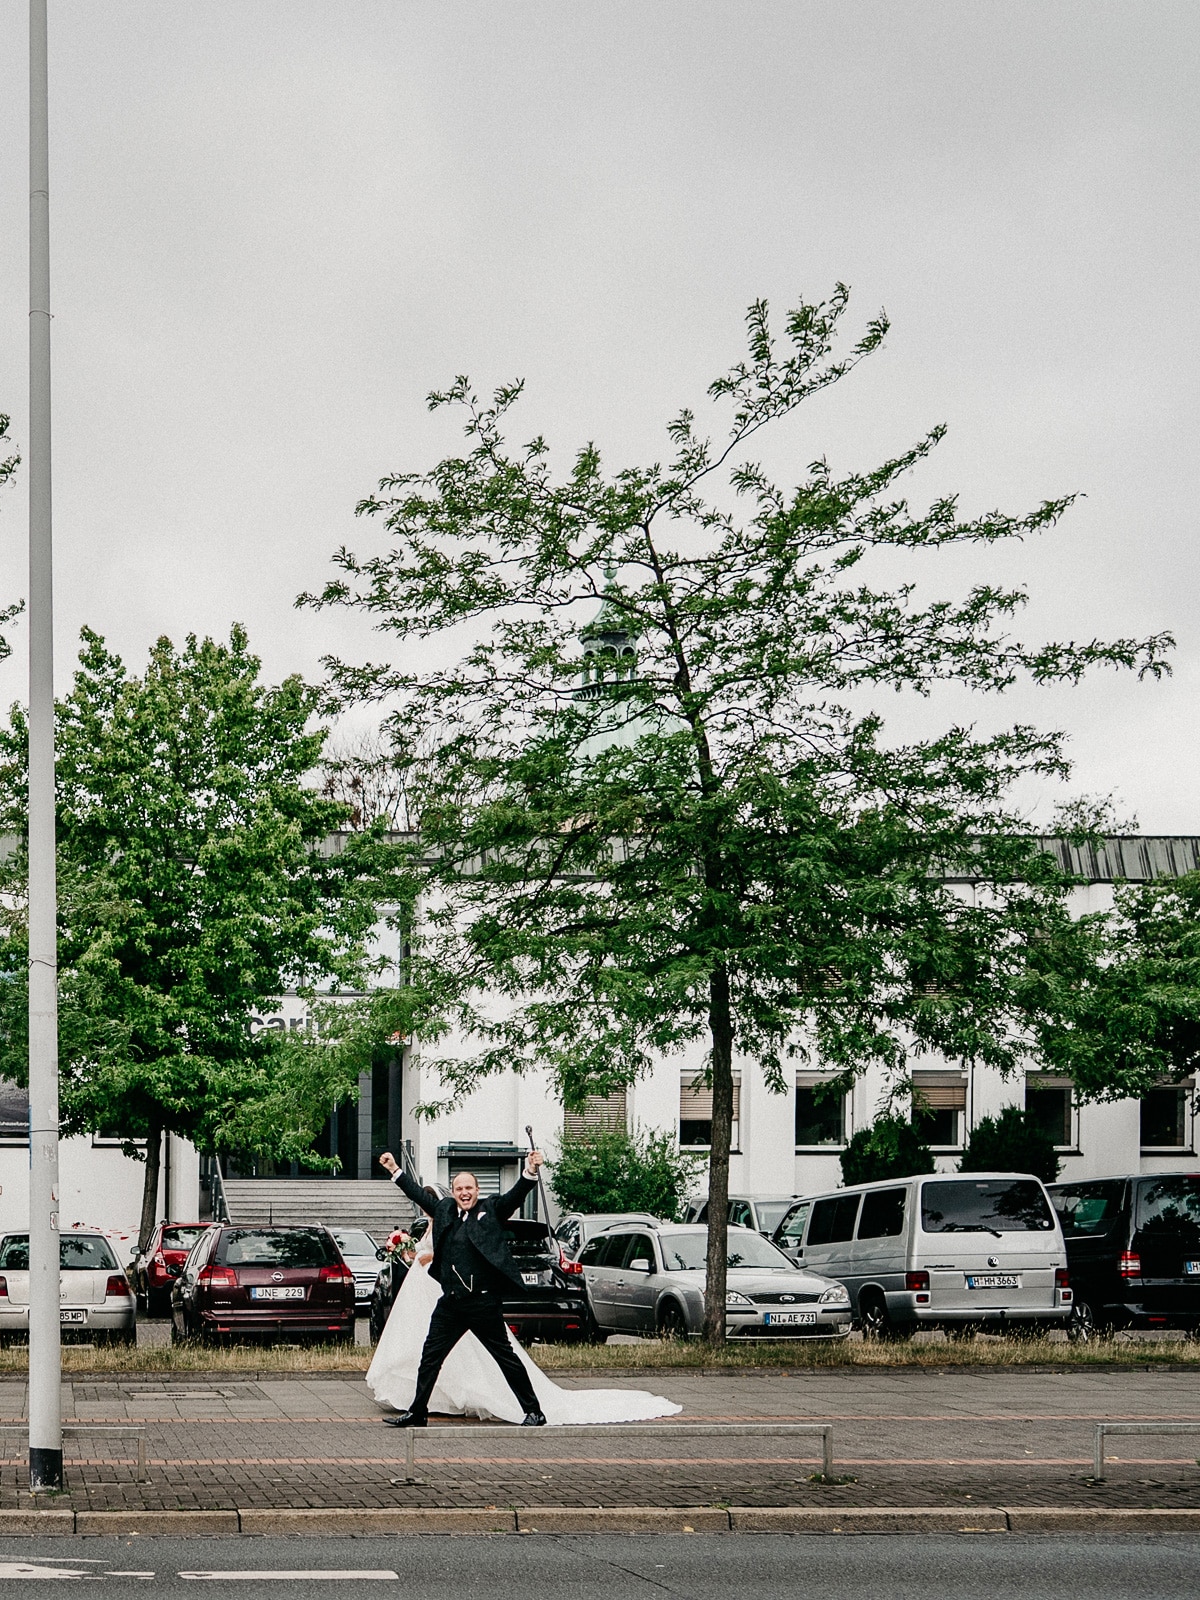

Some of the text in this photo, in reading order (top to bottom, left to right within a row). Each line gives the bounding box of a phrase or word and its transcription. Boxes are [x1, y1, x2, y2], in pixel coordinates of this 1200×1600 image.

[996, 1277, 1017, 1285] 3663
[257, 1288, 303, 1298] JNE 229
[799, 1314, 815, 1323] 731
